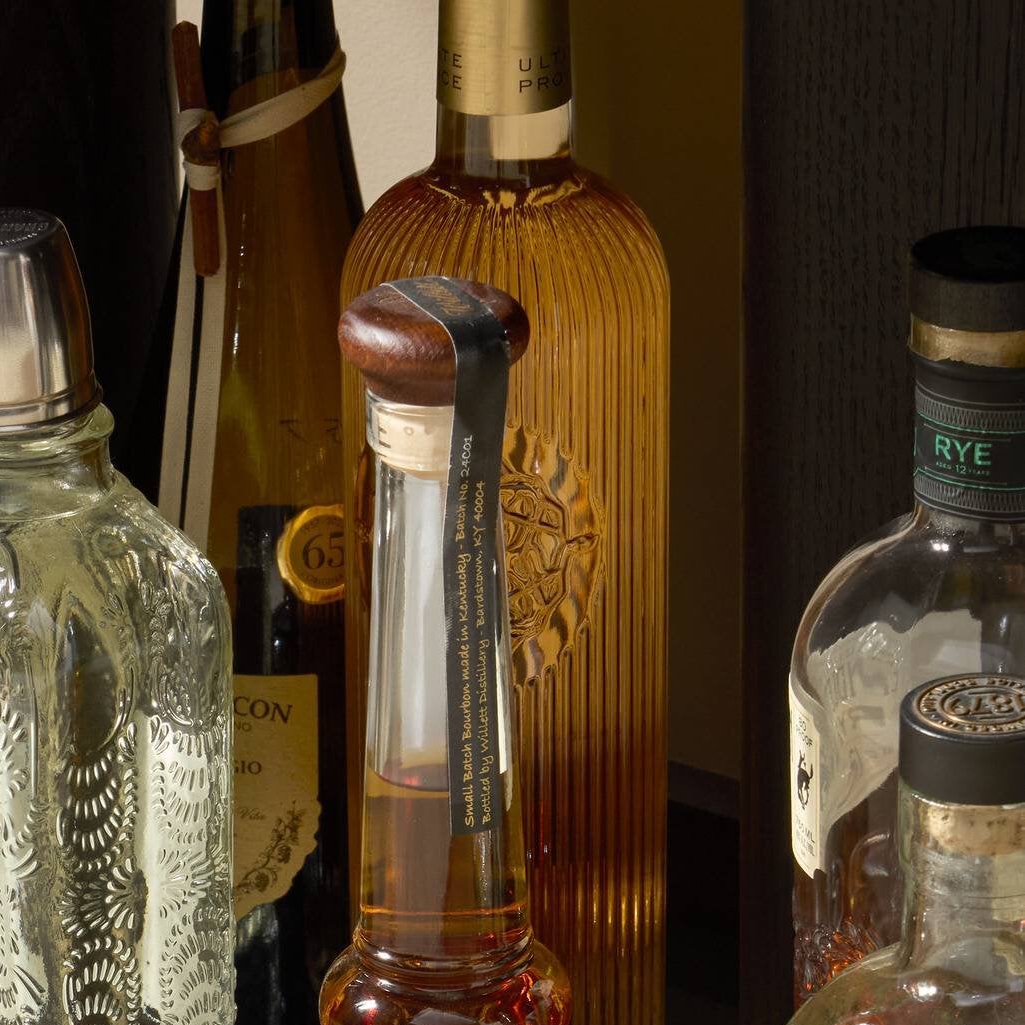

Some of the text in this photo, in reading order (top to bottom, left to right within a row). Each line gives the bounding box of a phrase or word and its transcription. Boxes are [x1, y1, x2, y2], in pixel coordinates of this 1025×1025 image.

[935, 434, 992, 466] RYE
[955, 465, 967, 475] 12
[459, 479, 469, 502] No.
[474, 480, 486, 523] 40004
[455, 504, 467, 542] Batch
[473, 526, 486, 547] KY
[302, 531, 344, 570] 65
[456, 552, 471, 622] Kentucky
[473, 550, 486, 629] Bardstown,
[457, 622, 469, 642] in
[458, 645, 471, 680] made
[476, 639, 490, 704] Distillery
[462, 682, 472, 741] Bourbon
[477, 705, 490, 751] Willett
[463, 743, 473, 782] Batch
[479, 755, 494, 775] by
[465, 783, 474, 827] Small
[481, 777, 492, 825] Bottled
